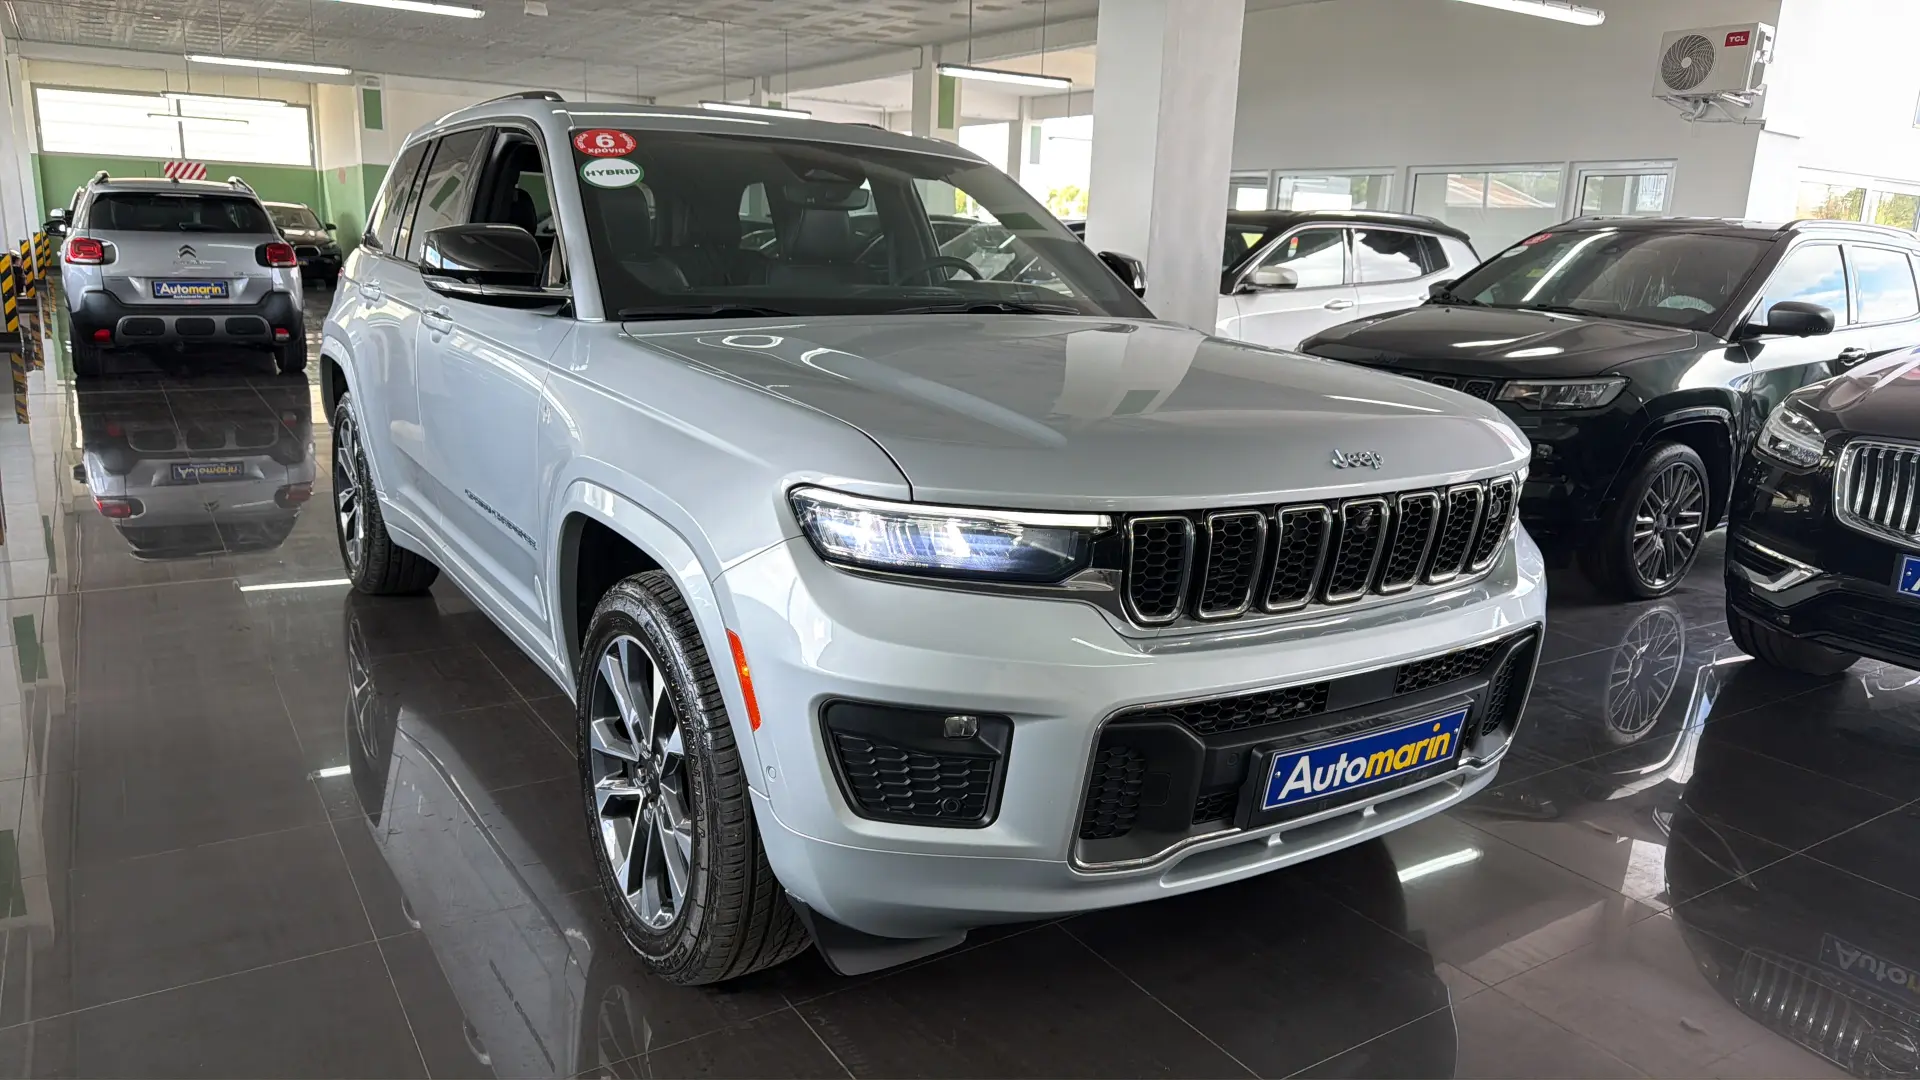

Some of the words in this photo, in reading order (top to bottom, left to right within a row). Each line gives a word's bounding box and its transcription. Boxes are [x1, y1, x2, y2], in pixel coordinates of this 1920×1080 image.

[595, 133, 615, 148] 6
[585, 168, 639, 177] HYBRID
[159, 282, 222, 295] Automarin
[1331, 448, 1384, 470] Jeep
[1277, 722, 1451, 800] Automarin
